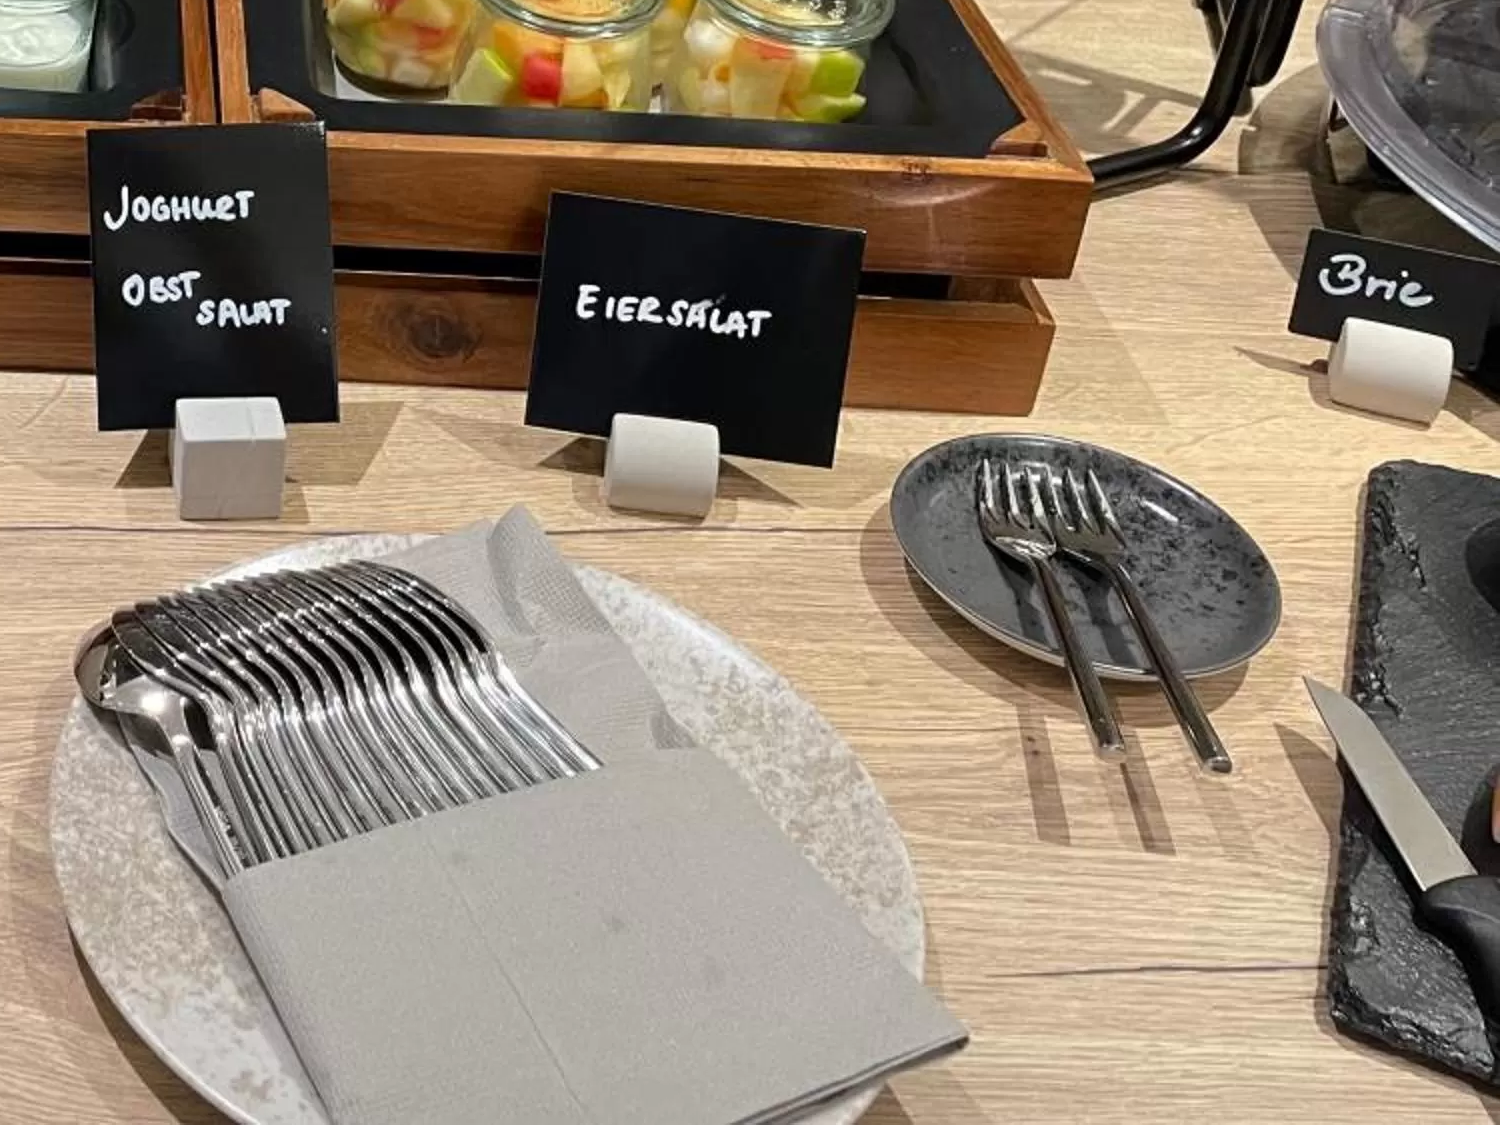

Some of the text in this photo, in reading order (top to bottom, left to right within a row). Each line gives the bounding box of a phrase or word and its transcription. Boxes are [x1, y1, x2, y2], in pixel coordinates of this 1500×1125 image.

[103, 185, 255, 231] JOGHURT
[121, 271, 201, 307] OBST
[1318, 253, 1434, 308] Brie
[196, 298, 292, 327] SALAT
[576, 284, 773, 339] EIERSALAT
